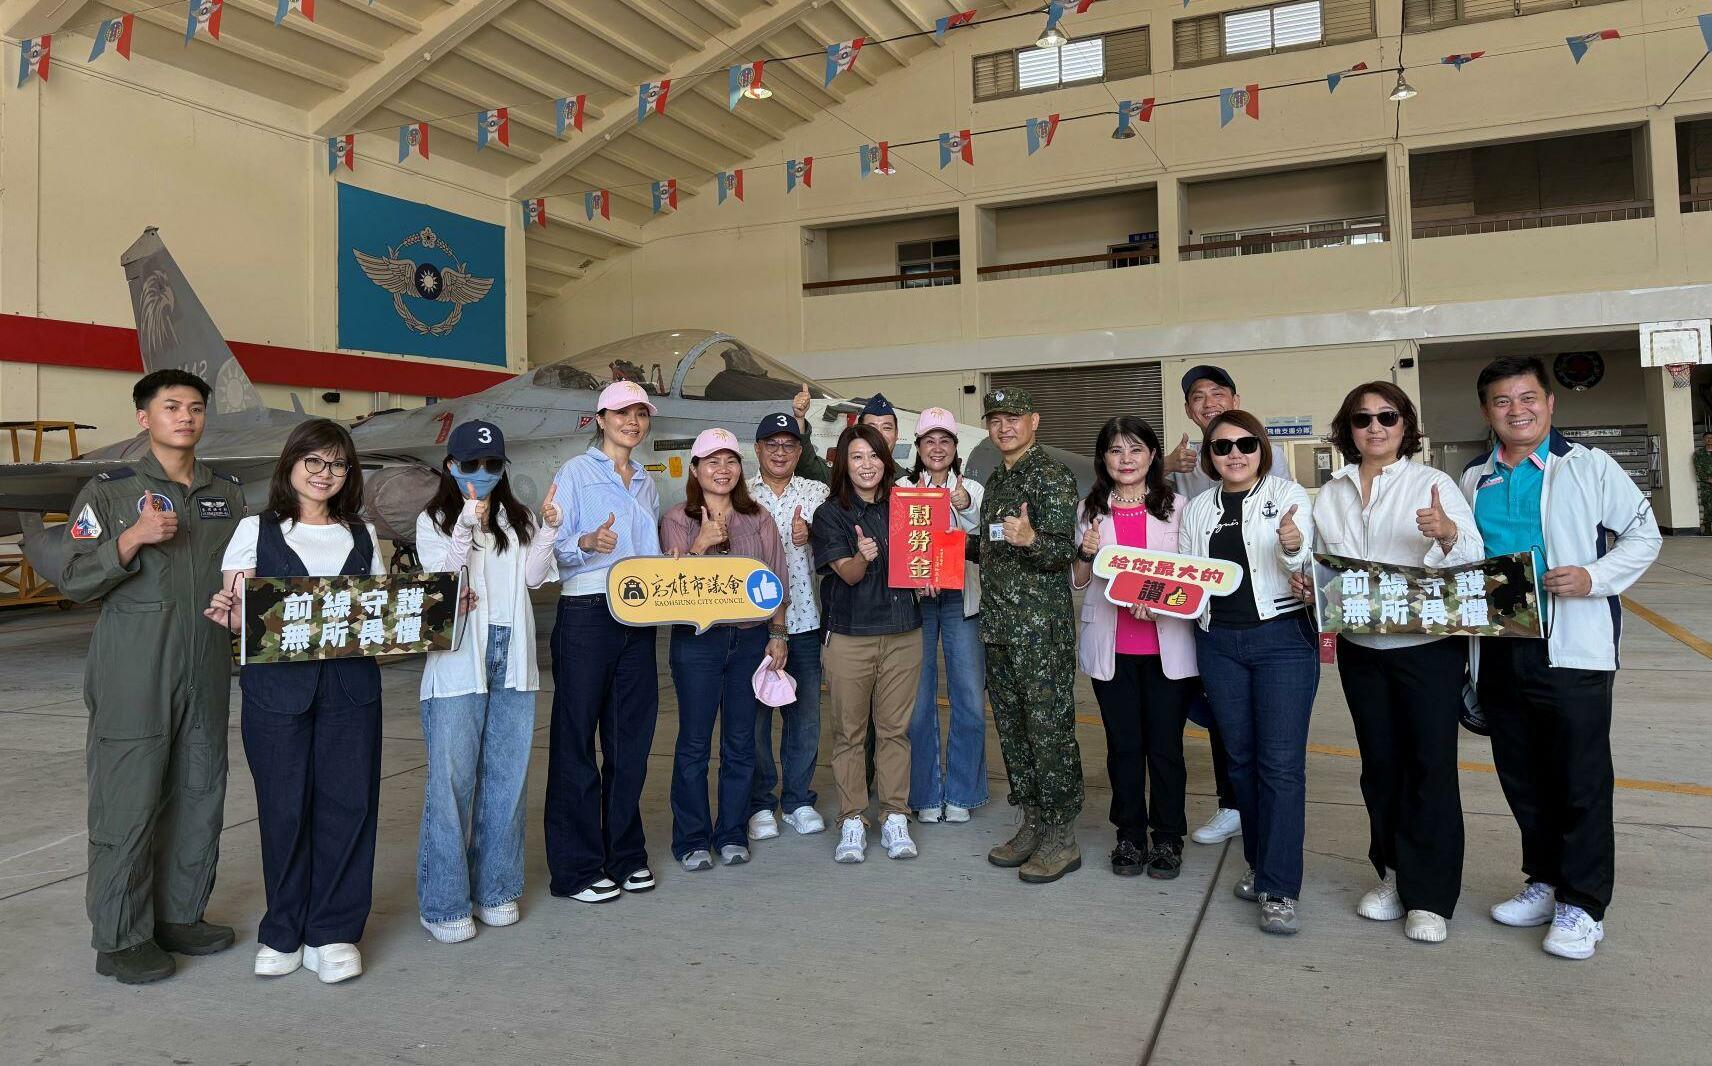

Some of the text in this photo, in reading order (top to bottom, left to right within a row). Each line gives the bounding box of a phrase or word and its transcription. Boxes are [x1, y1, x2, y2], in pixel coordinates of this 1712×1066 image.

[478, 427, 492, 443] 3
[776, 415, 788, 427] 3
[908, 504, 932, 579] 慰勞金
[1107, 554, 1224, 584] 給你最大的
[1341, 568, 1487, 597] 前線守護
[650, 572, 744, 599] 高雄市議會
[1137, 579, 1166, 604] 讚
[282, 587, 425, 622] 前線守護
[654, 597, 745, 607] KAOHSIUNG CITY COUNCIL
[1342, 598, 1490, 627] 無所畏懼
[280, 616, 423, 651] 無所畏懼
